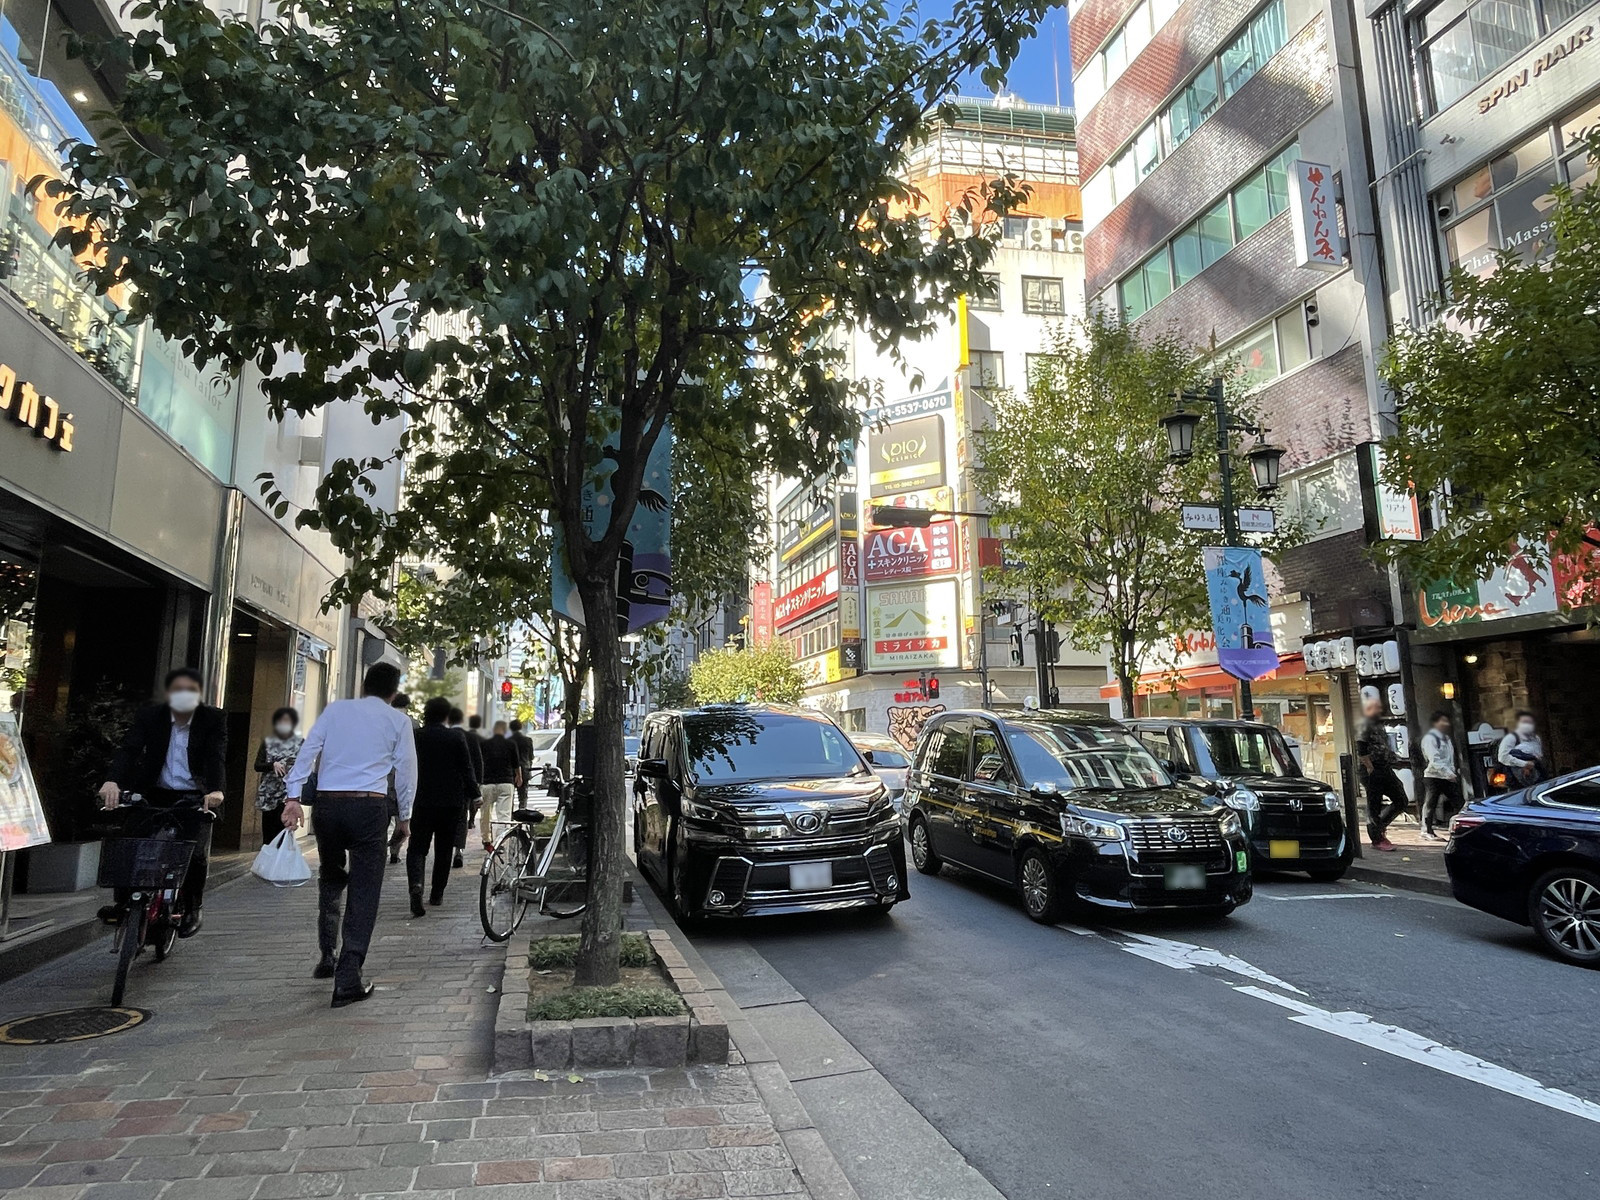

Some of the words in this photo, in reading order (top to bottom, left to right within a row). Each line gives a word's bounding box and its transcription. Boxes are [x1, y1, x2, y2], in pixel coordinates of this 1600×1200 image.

[1478, 69, 1529, 115] SPIN
[1533, 25, 1594, 77] HAIR
[867, 527, 929, 559] AGA
[846, 543, 857, 579] AGA
[877, 554, 929, 568] スキンクリニック
[883, 638, 940, 652] ミライザカ
[889, 653, 935, 661] MIRAIZAKA
[1389, 689, 1399, 710] つくね
